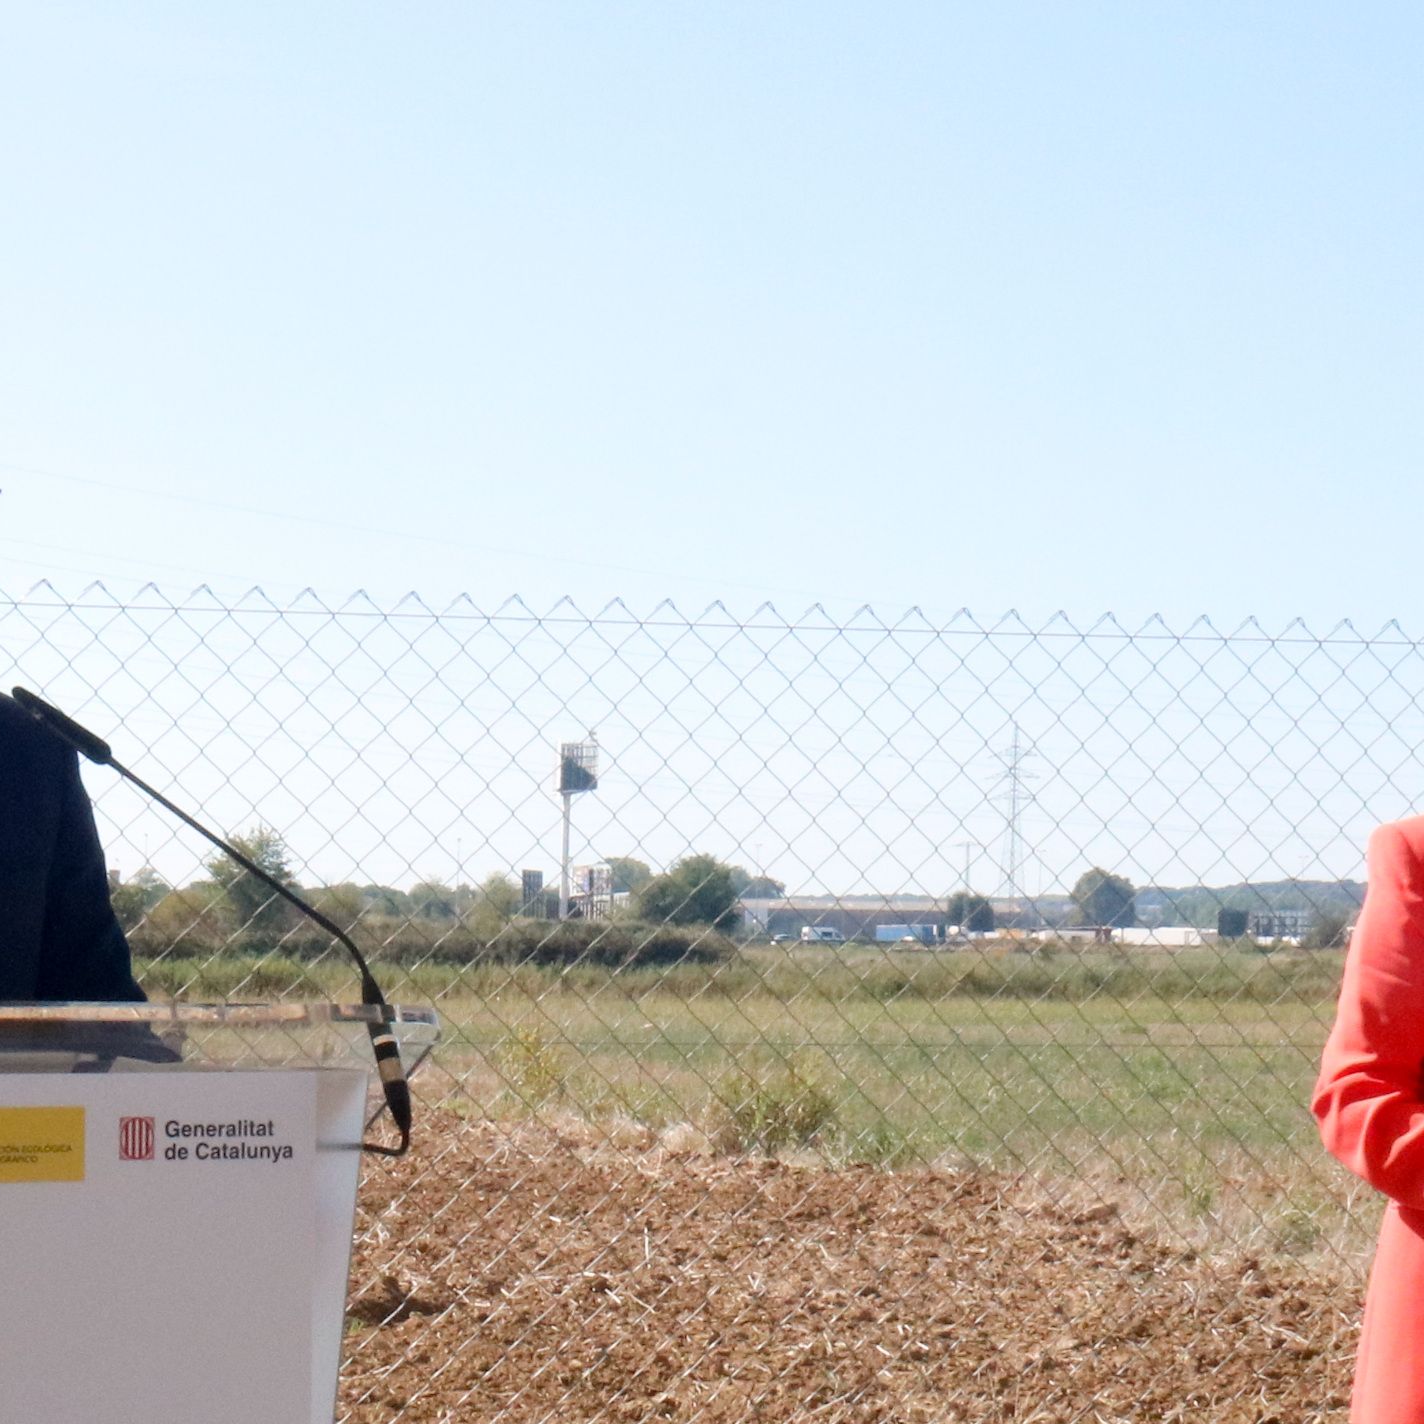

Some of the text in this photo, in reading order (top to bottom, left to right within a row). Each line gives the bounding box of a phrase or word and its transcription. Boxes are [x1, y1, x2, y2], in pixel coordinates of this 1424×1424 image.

[164, 1119, 275, 1138] Generalitat
[164, 1142, 294, 1163] de Catalunya
